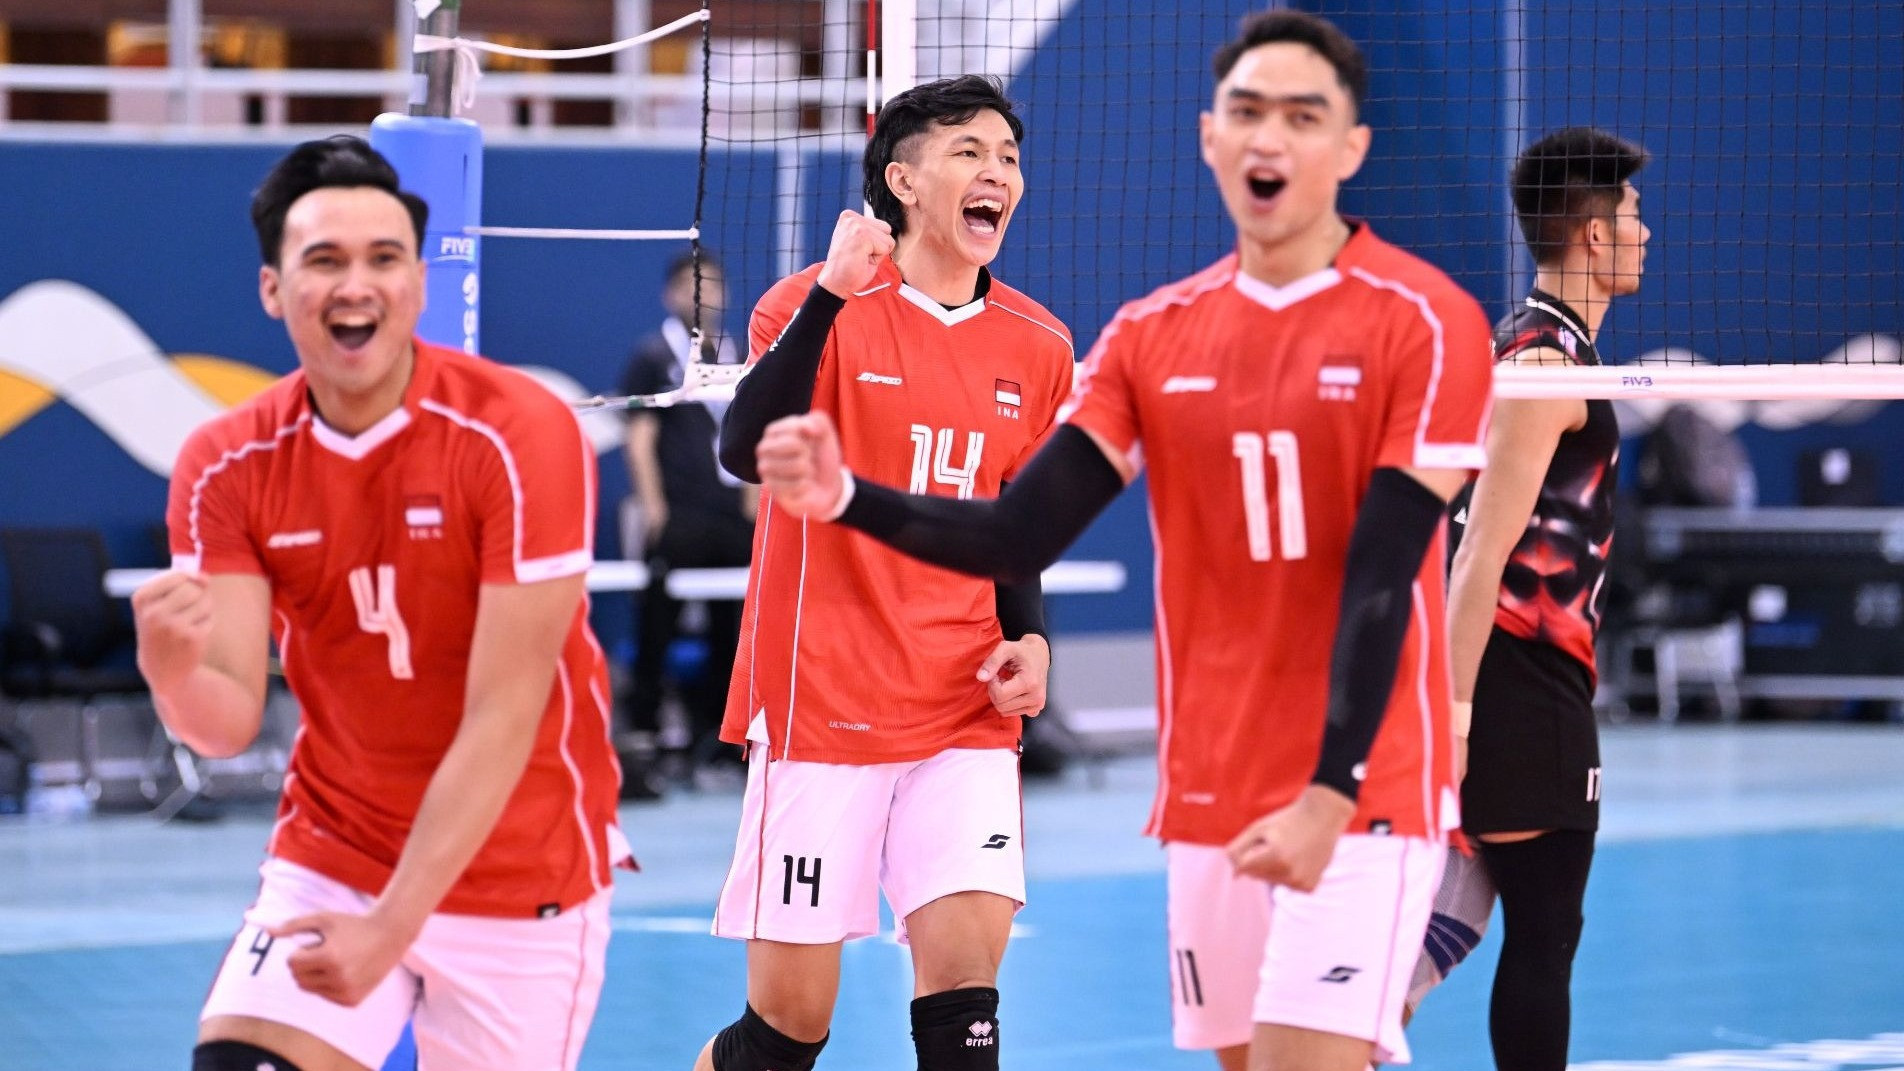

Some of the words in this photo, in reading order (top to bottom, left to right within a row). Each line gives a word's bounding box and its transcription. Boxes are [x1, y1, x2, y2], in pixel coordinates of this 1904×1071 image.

[998, 406, 1020, 420] INA
[910, 423, 985, 500] 14
[1232, 429, 1307, 562] 11
[349, 563, 415, 680] 4
[829, 720, 871, 731] ULTRADRY
[782, 854, 822, 907] 14
[249, 929, 275, 976] 4
[1176, 949, 1204, 1006] 11
